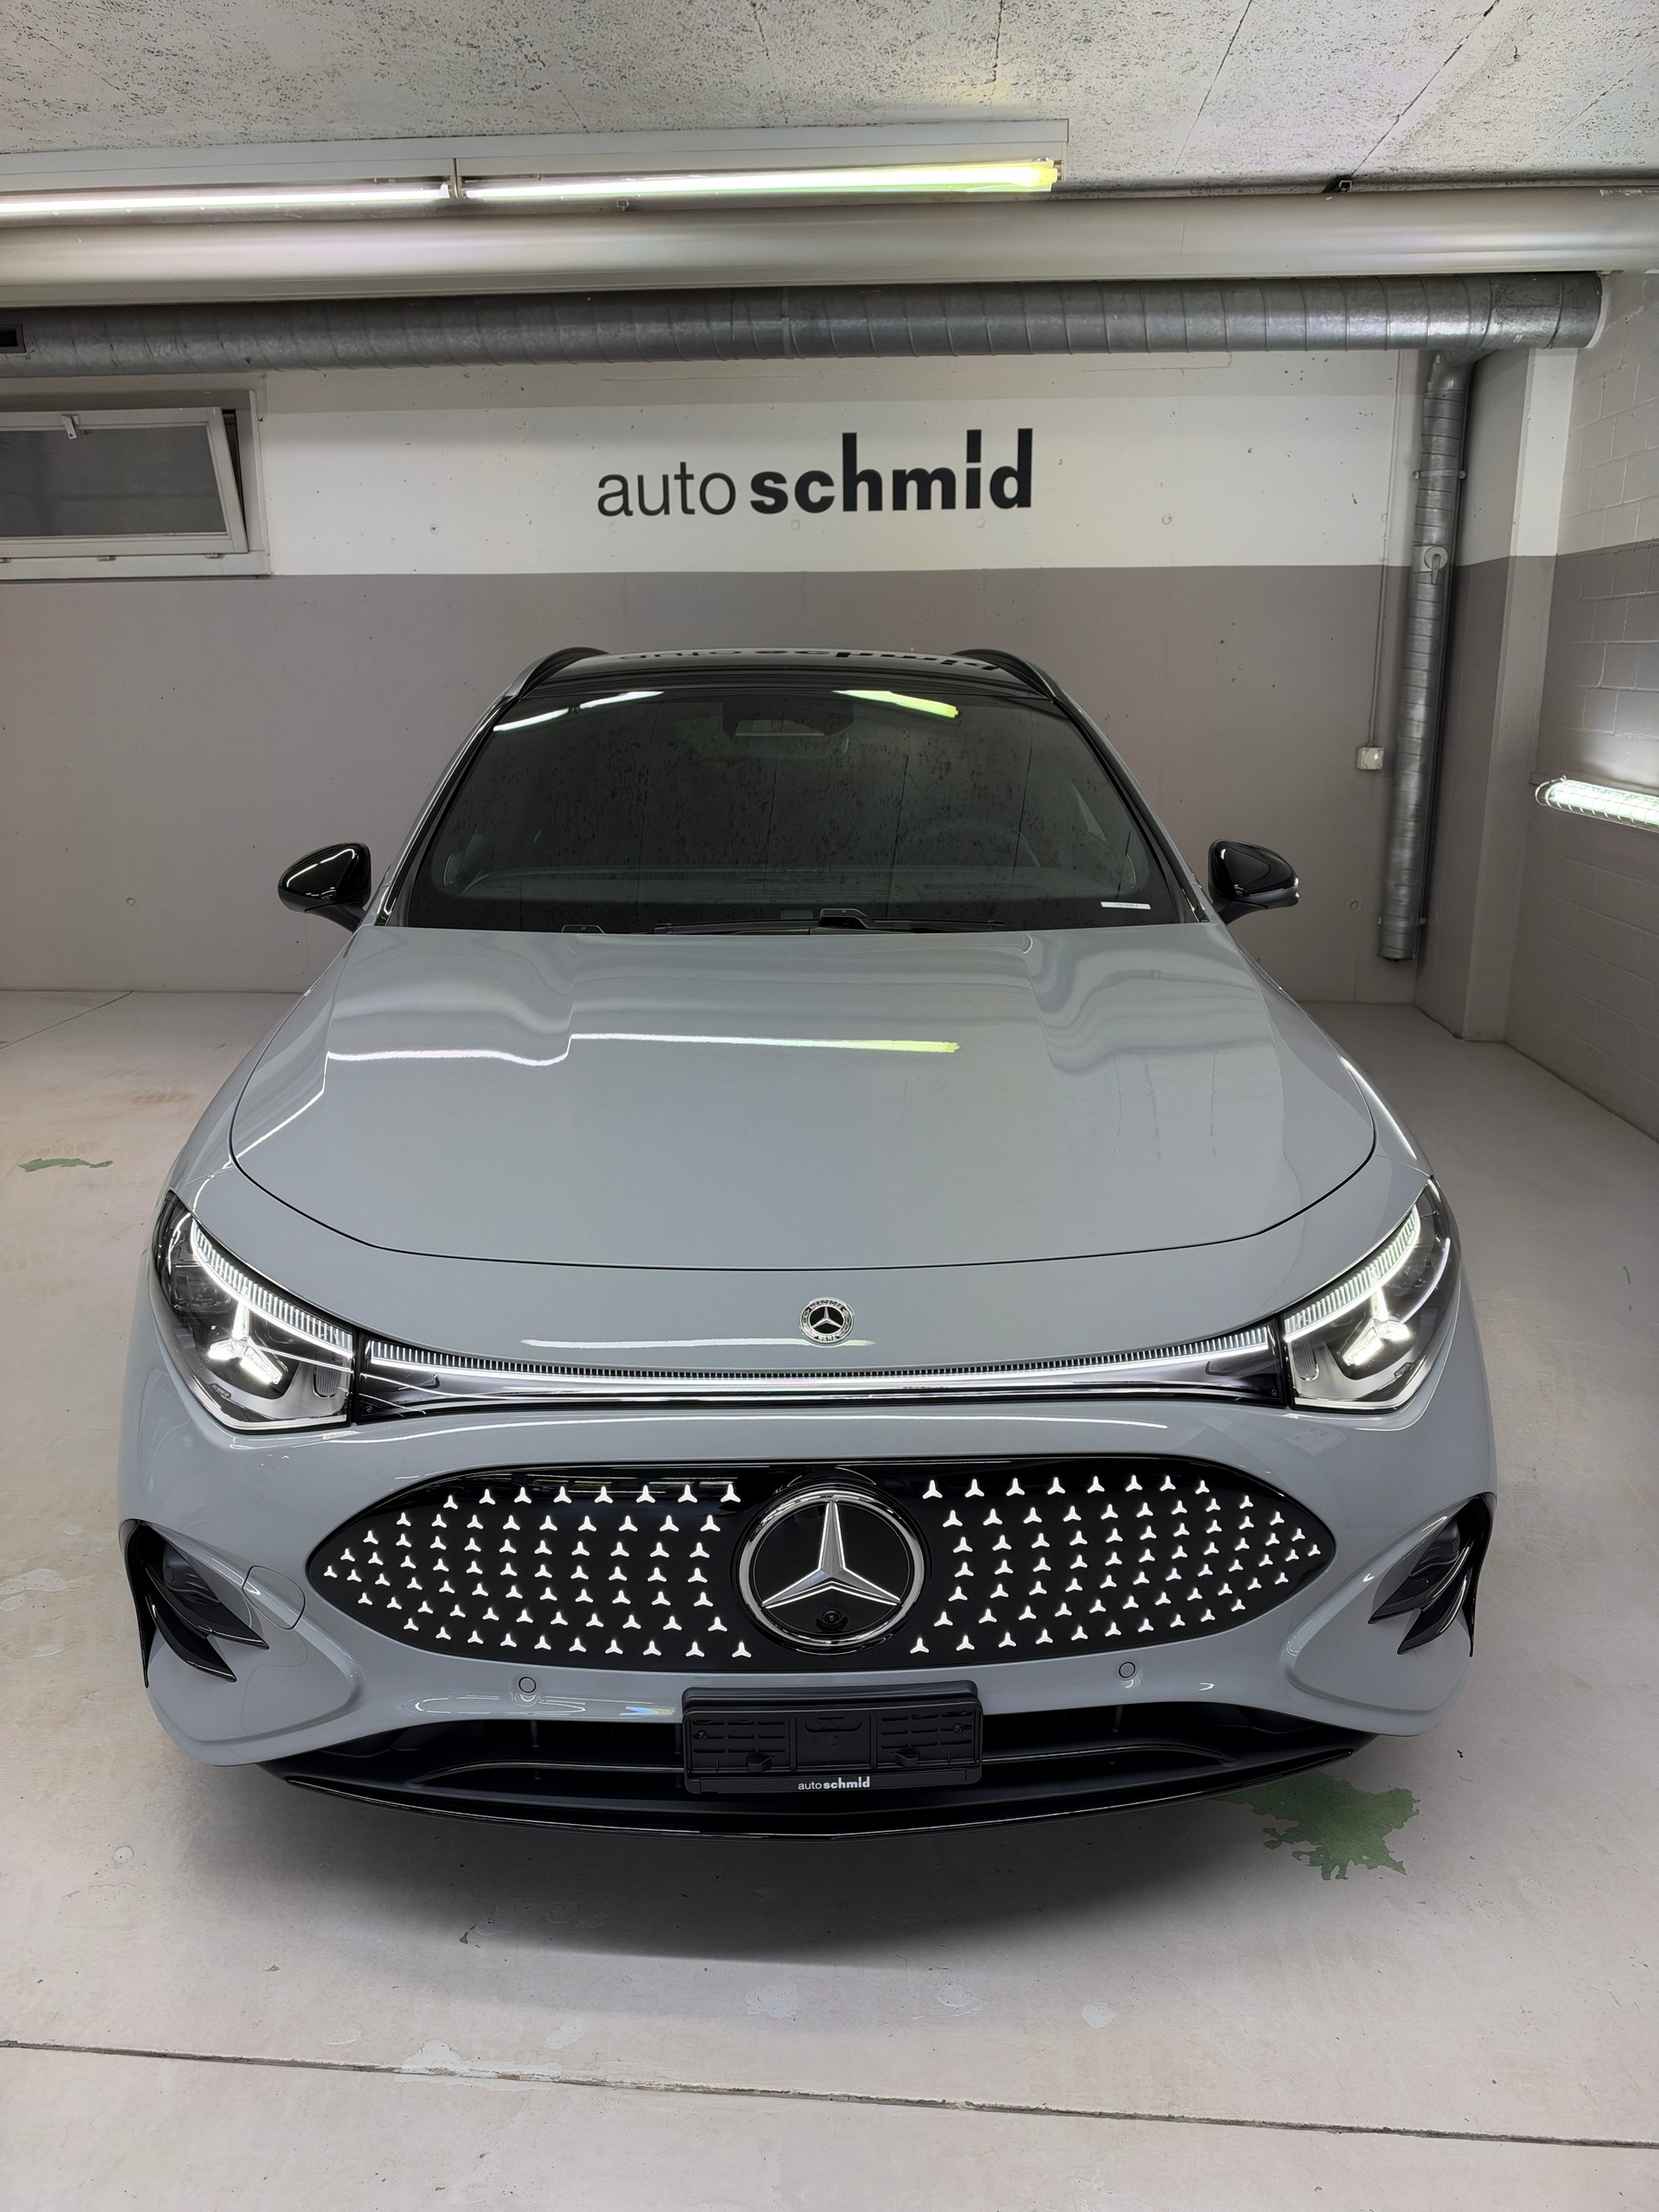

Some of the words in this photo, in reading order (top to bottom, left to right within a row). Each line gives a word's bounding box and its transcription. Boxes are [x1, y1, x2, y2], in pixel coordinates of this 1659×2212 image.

[597, 461, 736, 517] auto
[750, 428, 1033, 515] schmid
[798, 1781, 823, 1790] auto
[823, 1776, 870, 1789] schmid
